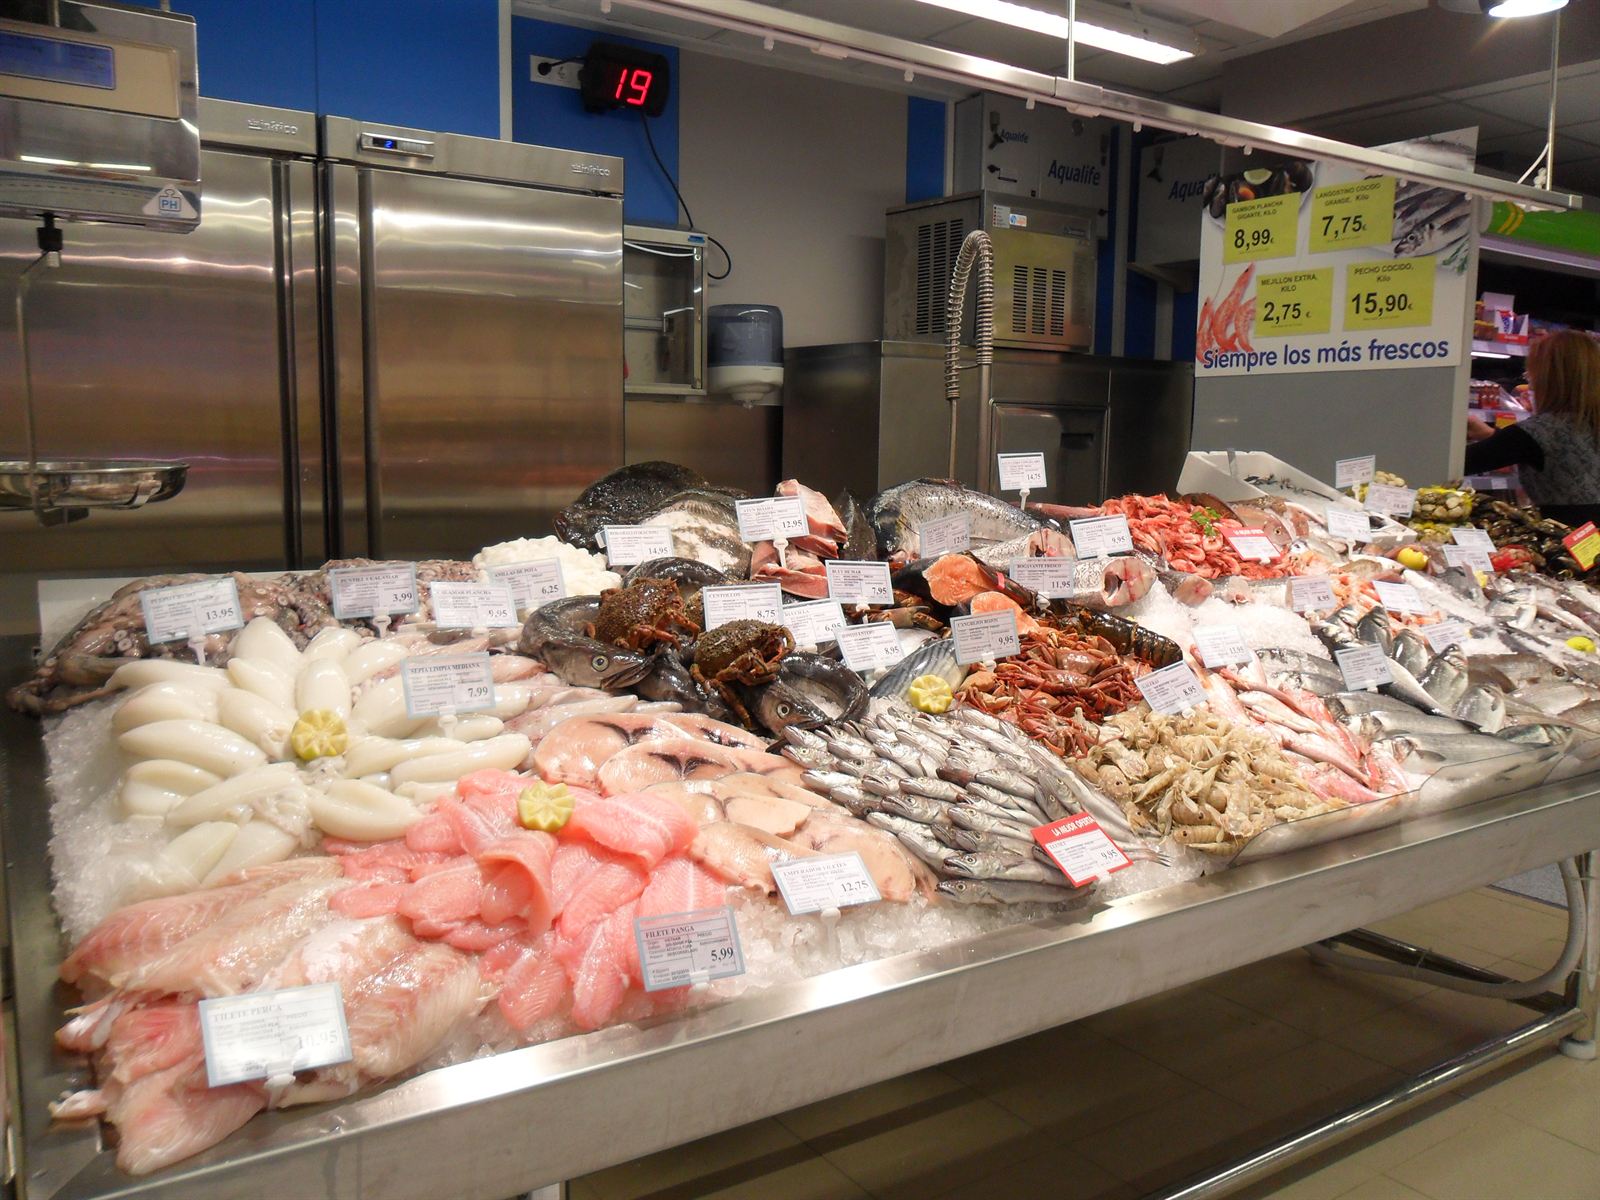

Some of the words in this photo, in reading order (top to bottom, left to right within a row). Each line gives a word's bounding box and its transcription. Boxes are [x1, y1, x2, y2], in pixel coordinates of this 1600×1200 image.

[615, 68, 652, 106] 19
[1000, 128, 1029, 144] Aqualife
[384, 140, 393, 149] 2
[1047, 159, 1100, 187] Aqualife
[1315, 187, 1354, 200] LANGOSTINO
[1355, 182, 1381, 192] COCIDO
[1355, 193, 1369, 201] Kilo
[160, 198, 178, 210] PH
[1256, 200, 1283, 210] PLANCHA
[1354, 266, 1381, 276] PECHO
[1261, 276, 1293, 286] MEJILLON
[1376, 274, 1391, 283] Kilo
[1280, 284, 1297, 293] KILO
[1263, 302, 1301, 325] 2,75
[1203, 350, 1278, 372] Siempre
[1284, 344, 1311, 365] los
[1317, 340, 1362, 363] más
[1368, 338, 1449, 361] frescos
[840, 880, 869, 892] 12,75
[645, 930, 669, 939] FILETE
[671, 925, 695, 934] PANGA
[710, 947, 734, 962] 5,99
[214, 1010, 246, 1022] FILETE
[251, 1004, 282, 1016] PERCA
